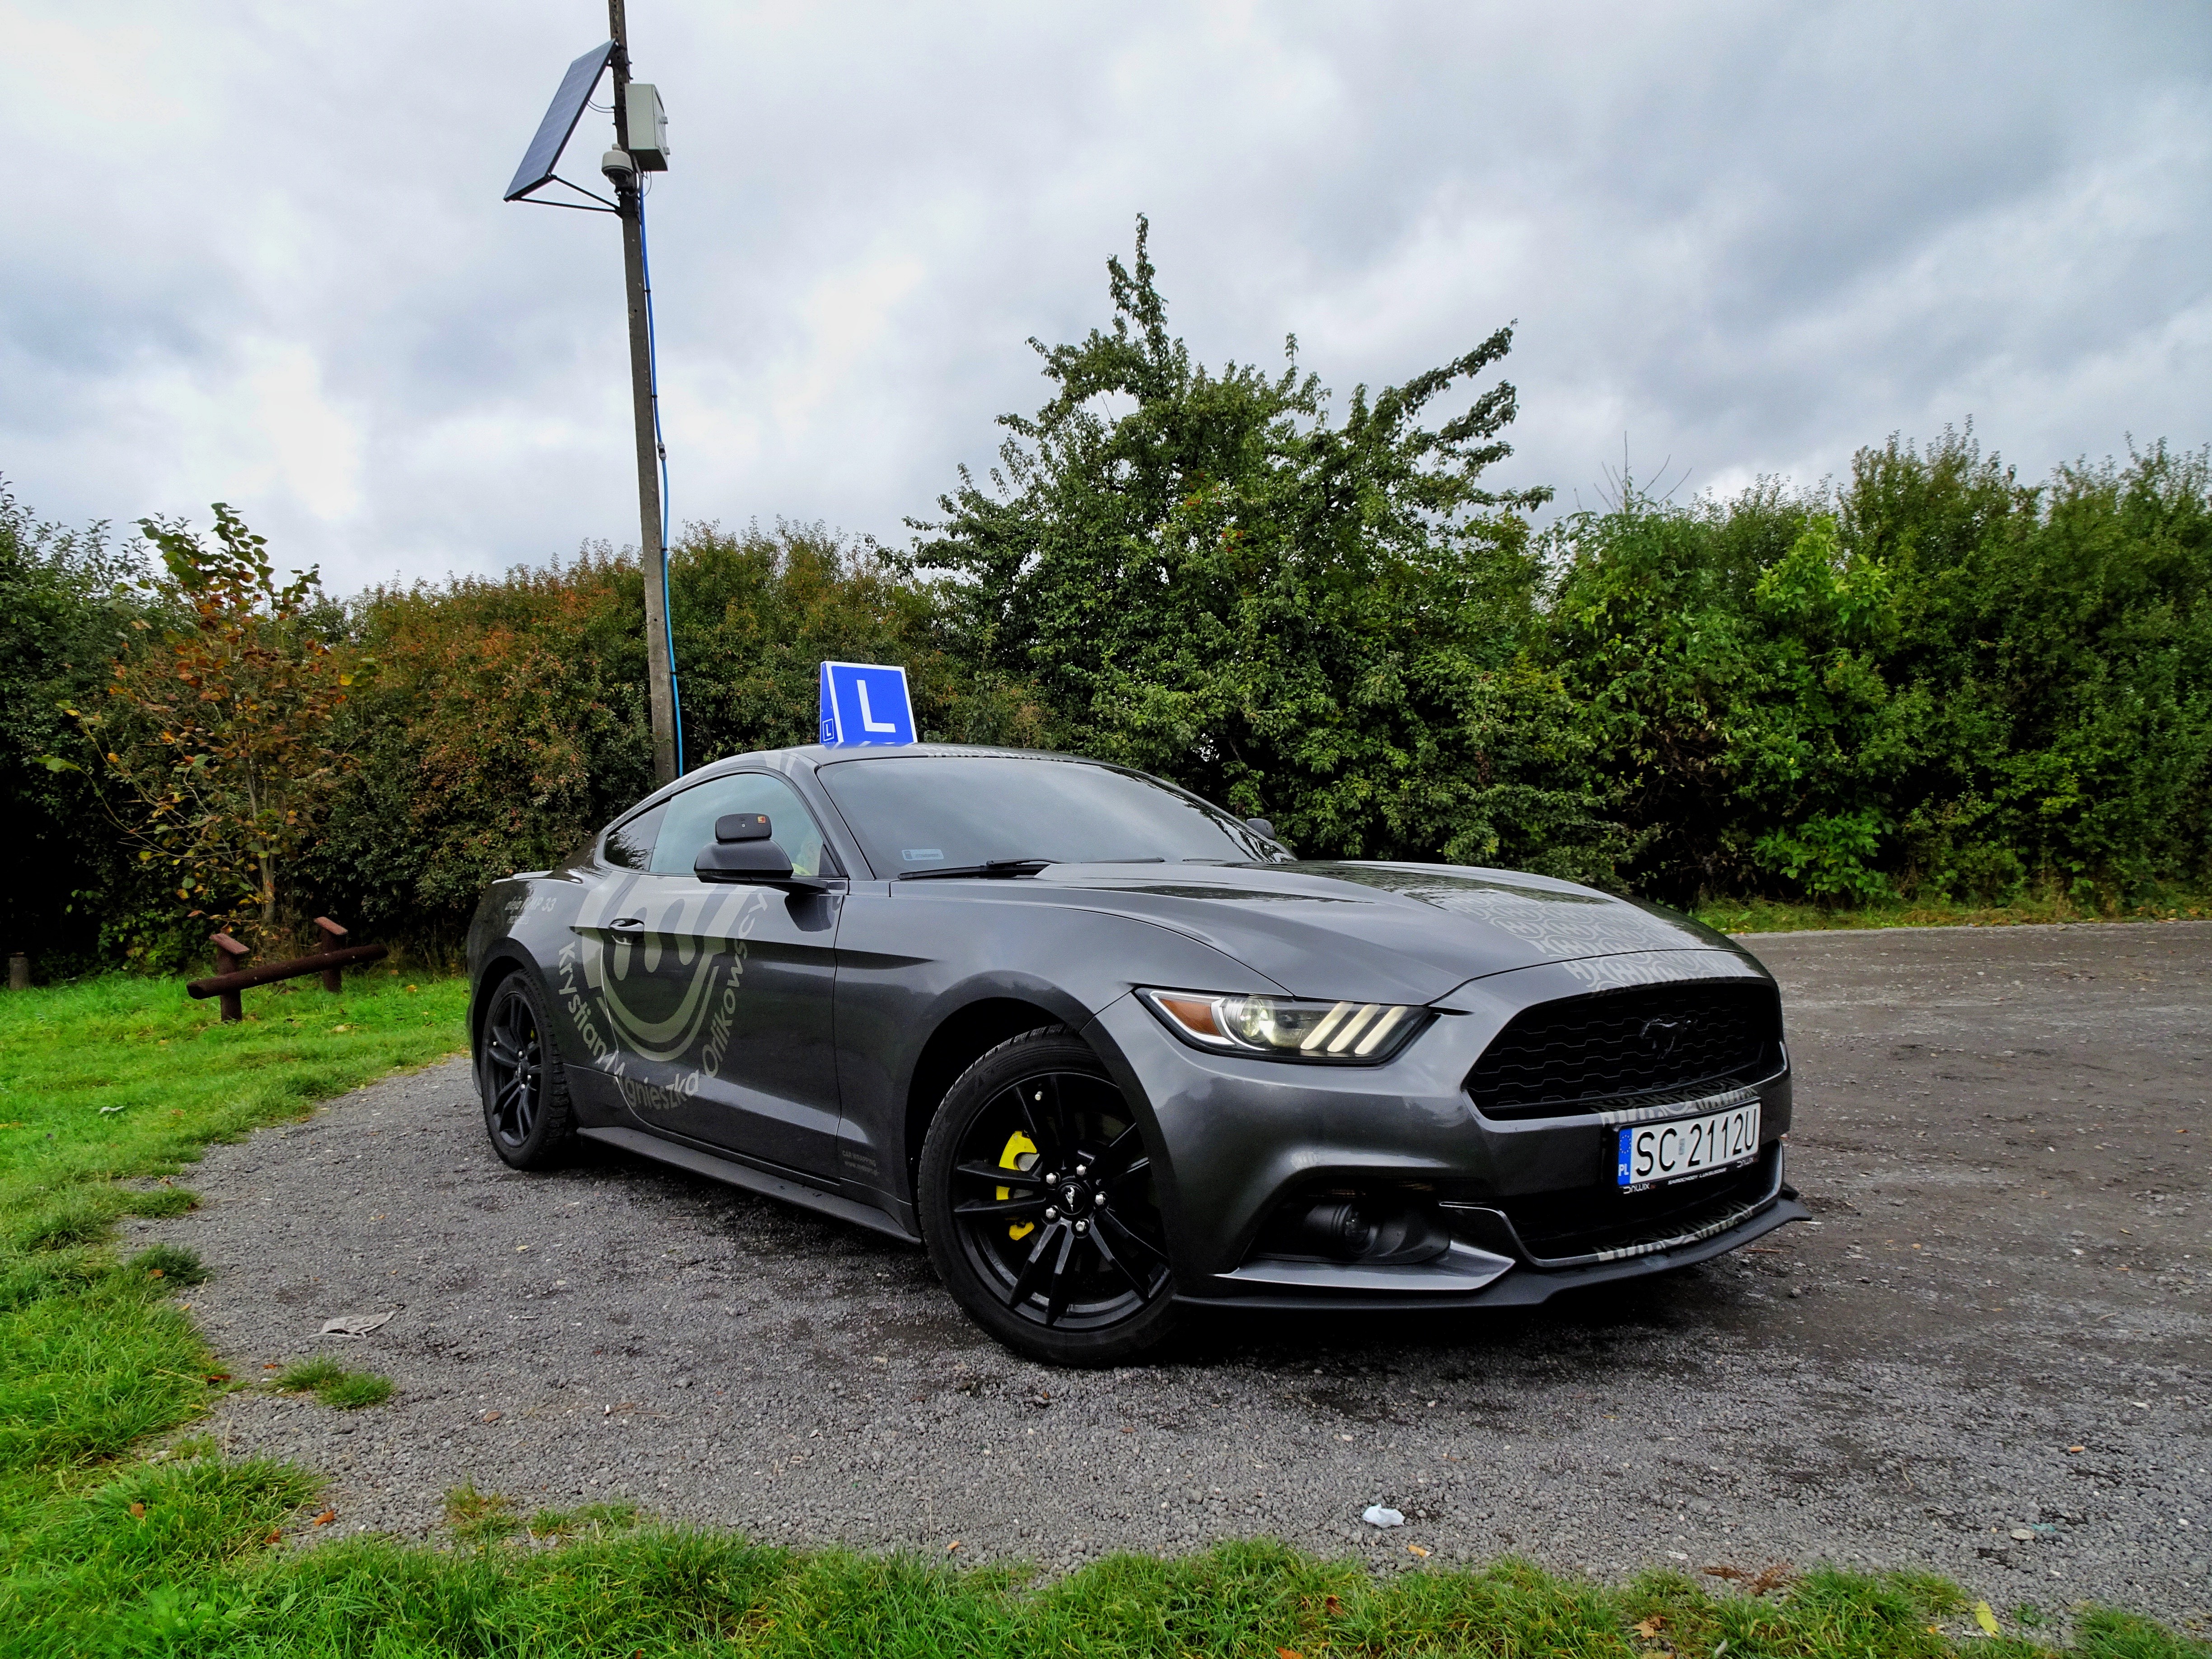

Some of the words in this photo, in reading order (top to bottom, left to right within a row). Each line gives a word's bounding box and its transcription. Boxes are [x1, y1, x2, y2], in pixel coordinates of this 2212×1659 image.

[857, 679, 896, 733] L
[825, 723, 832, 737] L
[542, 897, 557, 912] 33
[558, 941, 608, 1064] Krystian
[702, 893, 768, 1078] Orlikowscy
[1635, 1127, 1678, 1176] SC
[1687, 1108, 1757, 1167] 2112U
[1618, 1163, 1630, 1176] PL
